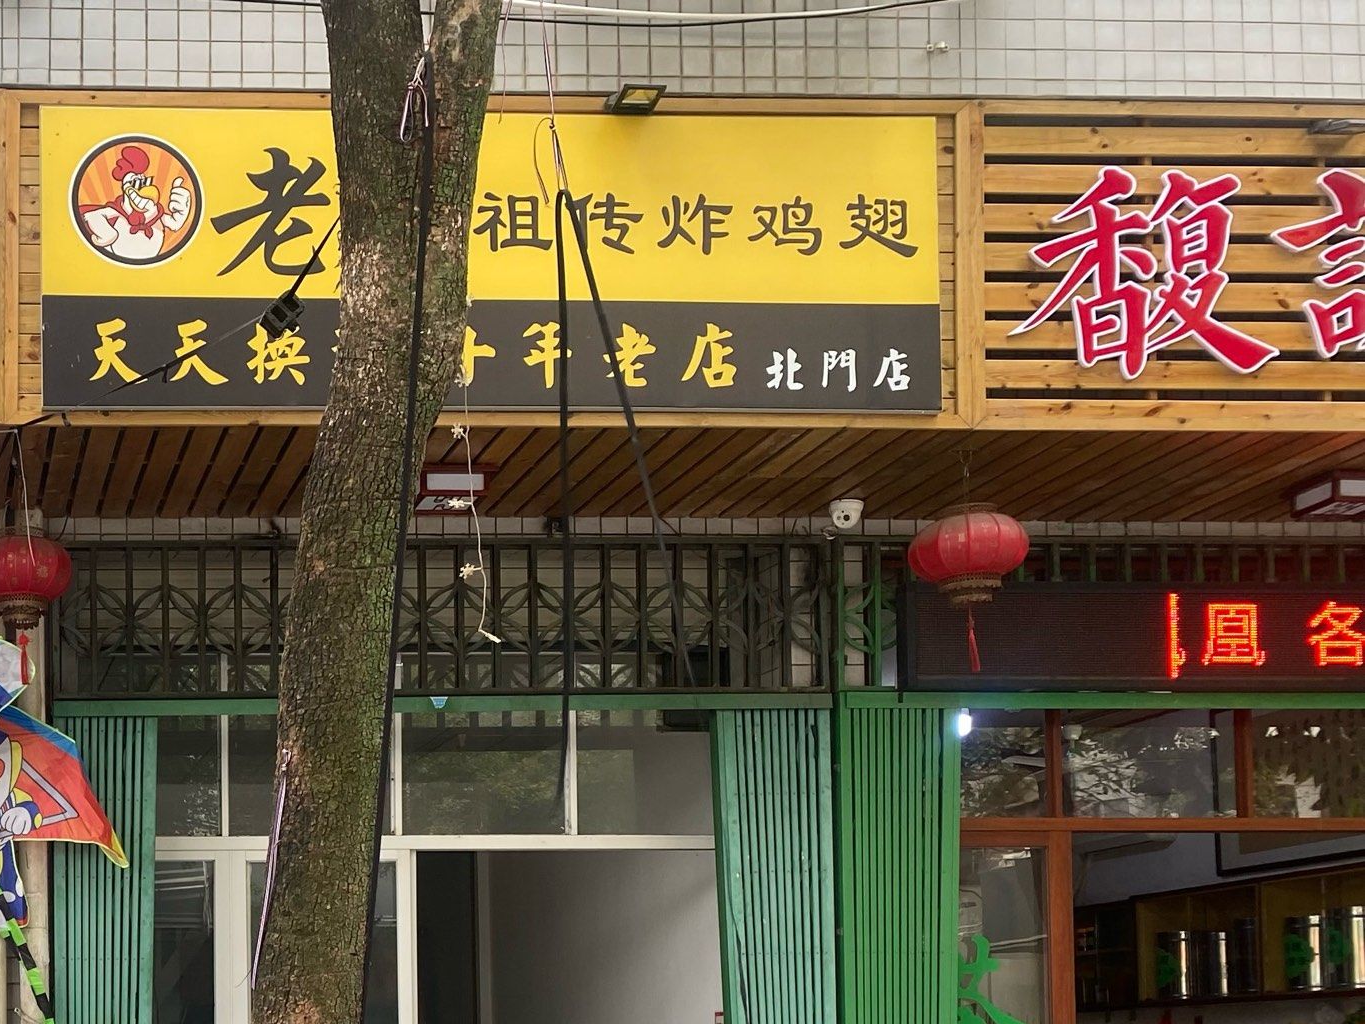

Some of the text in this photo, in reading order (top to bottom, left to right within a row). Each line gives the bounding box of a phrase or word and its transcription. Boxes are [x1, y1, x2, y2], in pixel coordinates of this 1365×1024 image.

[473, 190, 920, 259] 祖传炸鸡翅
[766, 347, 913, 392] 北門店
